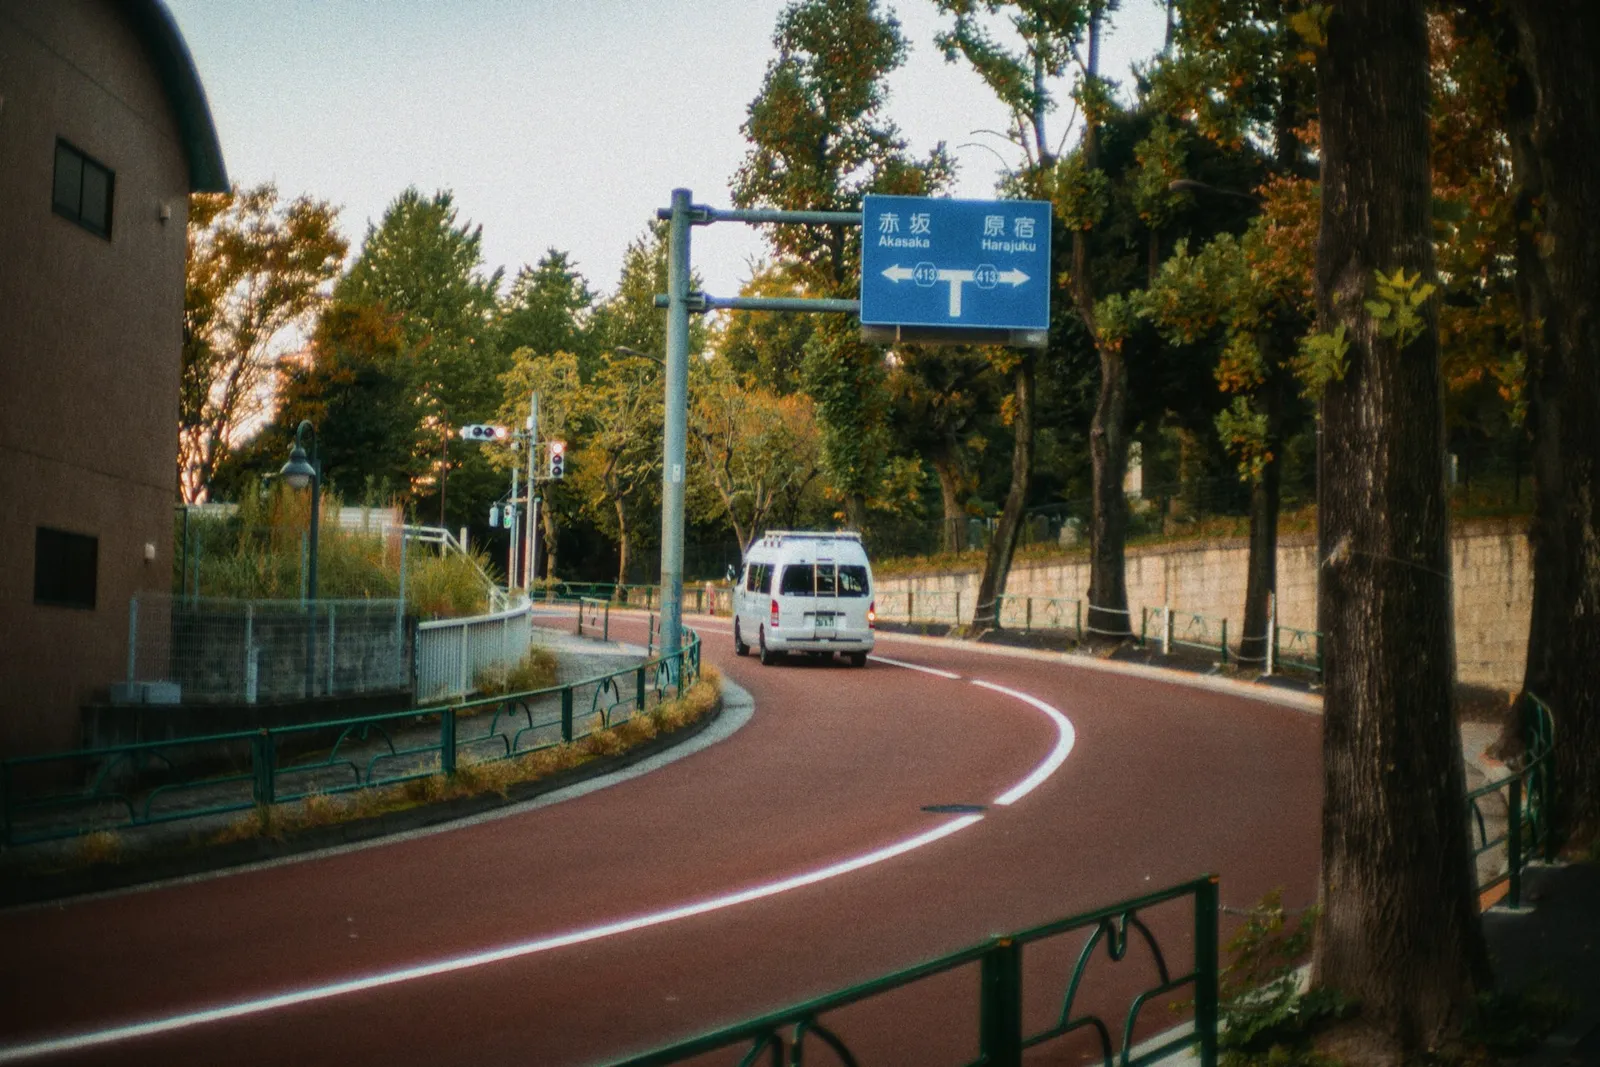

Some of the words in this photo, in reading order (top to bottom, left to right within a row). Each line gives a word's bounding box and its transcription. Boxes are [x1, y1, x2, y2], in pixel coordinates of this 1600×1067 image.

[878, 211, 931, 235] 赤坂
[983, 214, 1036, 238] 原宿
[878, 236, 930, 248] Akasaka
[982, 239, 1037, 253] Harajuku
[915, 268, 935, 280] 413
[976, 270, 996, 282] 413
